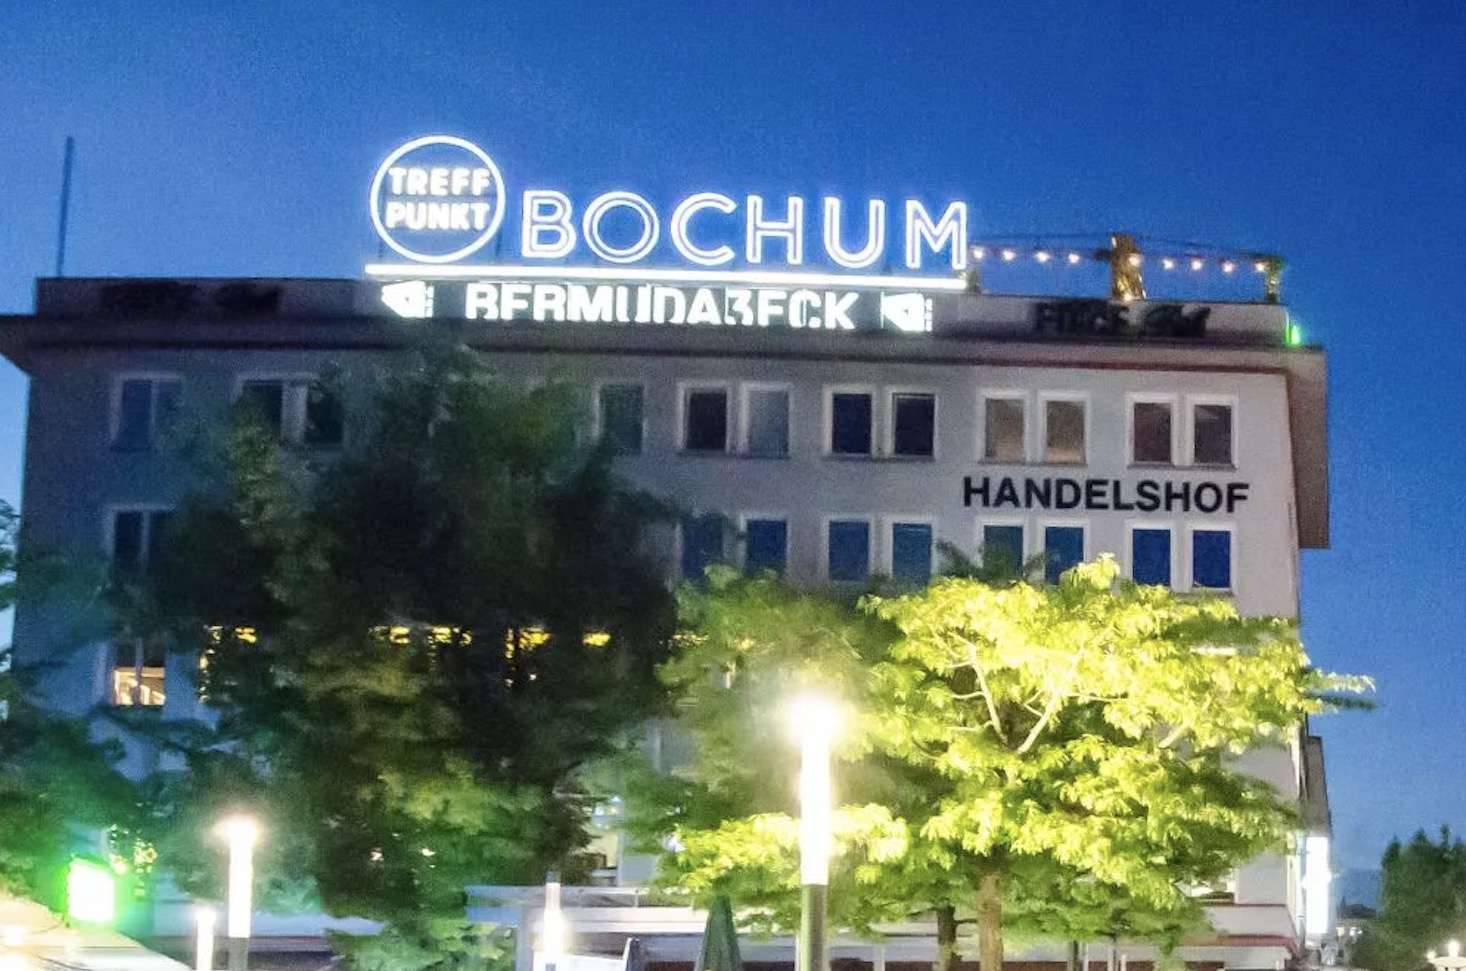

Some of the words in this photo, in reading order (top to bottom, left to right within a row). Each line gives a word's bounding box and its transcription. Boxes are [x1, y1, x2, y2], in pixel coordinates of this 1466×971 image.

[388, 166, 491, 198] TREFF
[385, 200, 490, 231] PUNKT
[519, 188, 968, 271] BOCHUM
[962, 475, 1250, 514] HANDELSHOF
